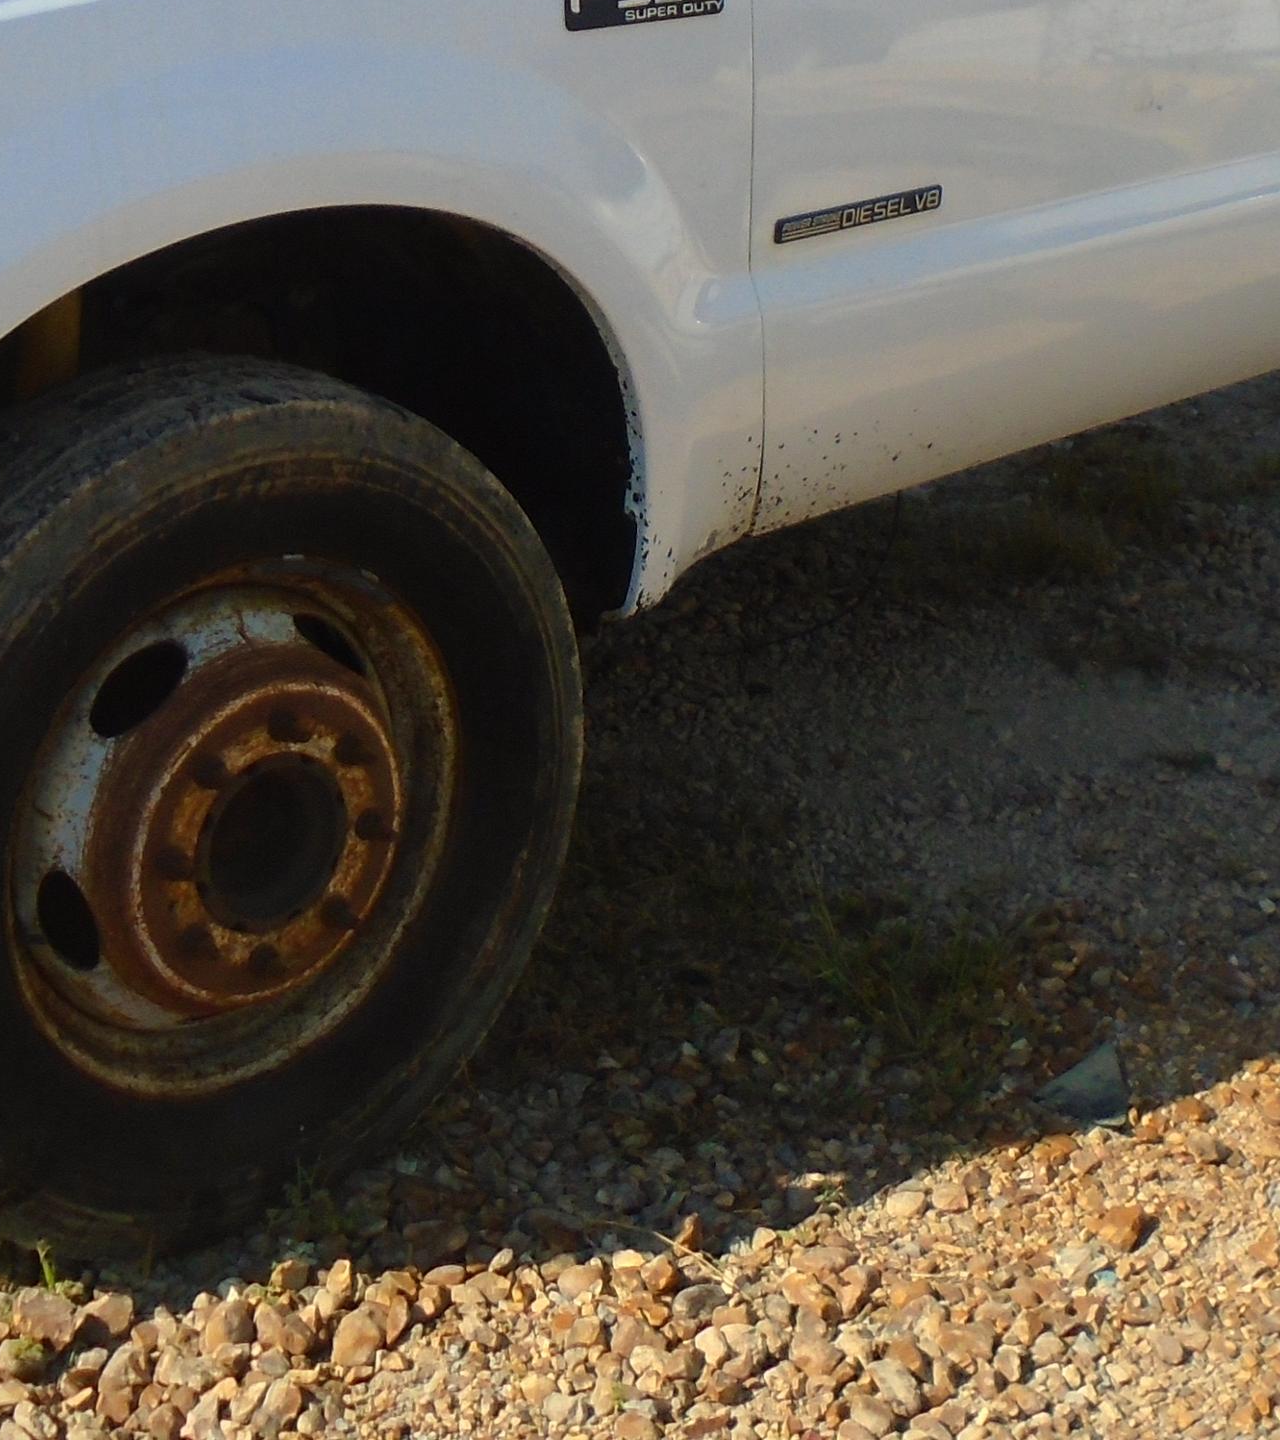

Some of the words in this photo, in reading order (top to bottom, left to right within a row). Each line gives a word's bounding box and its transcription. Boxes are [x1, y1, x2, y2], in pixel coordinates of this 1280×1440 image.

[624, 5, 678, 22] SUPER
[682, 0, 723, 14] DUTY
[842, 197, 911, 228] DIESEL
[914, 189, 940, 210] V8
